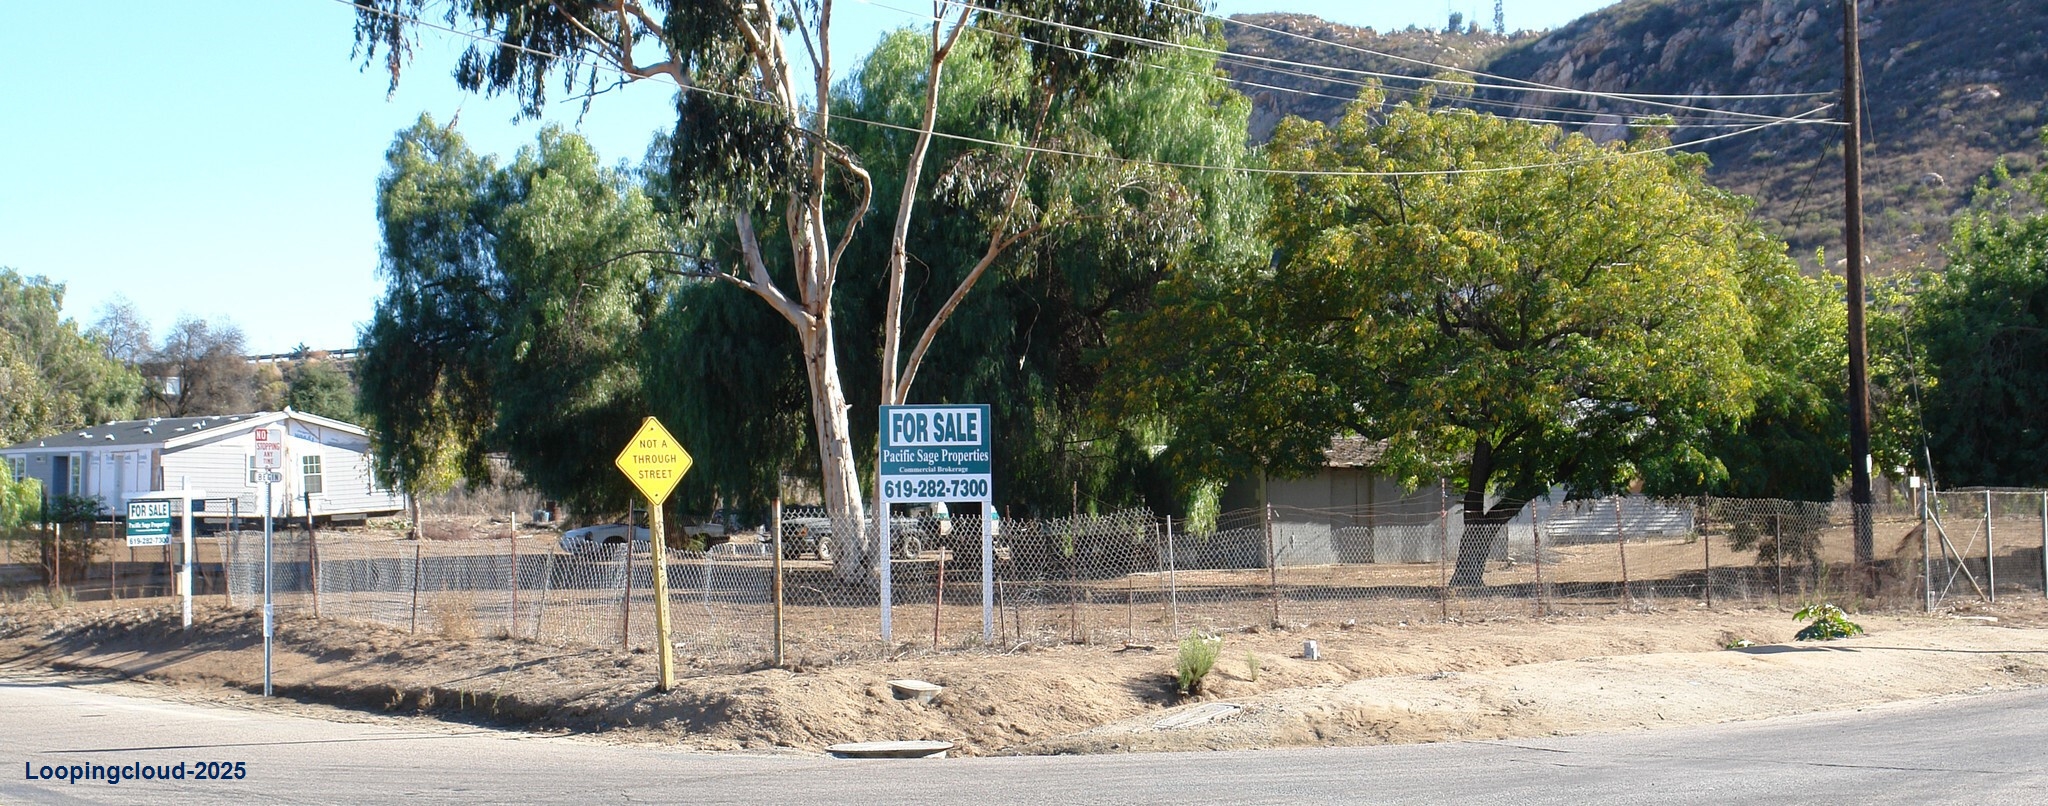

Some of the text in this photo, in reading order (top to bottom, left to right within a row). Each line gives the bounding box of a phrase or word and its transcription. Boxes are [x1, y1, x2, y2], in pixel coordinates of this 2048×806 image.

[893, 412, 977, 442] FOR SALE
[256, 431, 266, 440] NO
[640, 440, 667, 448] NOT A
[633, 454, 677, 464] THROUGH
[883, 449, 989, 465] Pacific Sage Properties
[639, 470, 672, 479] STREET
[937, 466, 968, 474] Brokerage
[258, 473, 279, 481] BEGIN
[884, 479, 988, 498] 619-282-7300
[131, 504, 167, 517] FOR SALE
